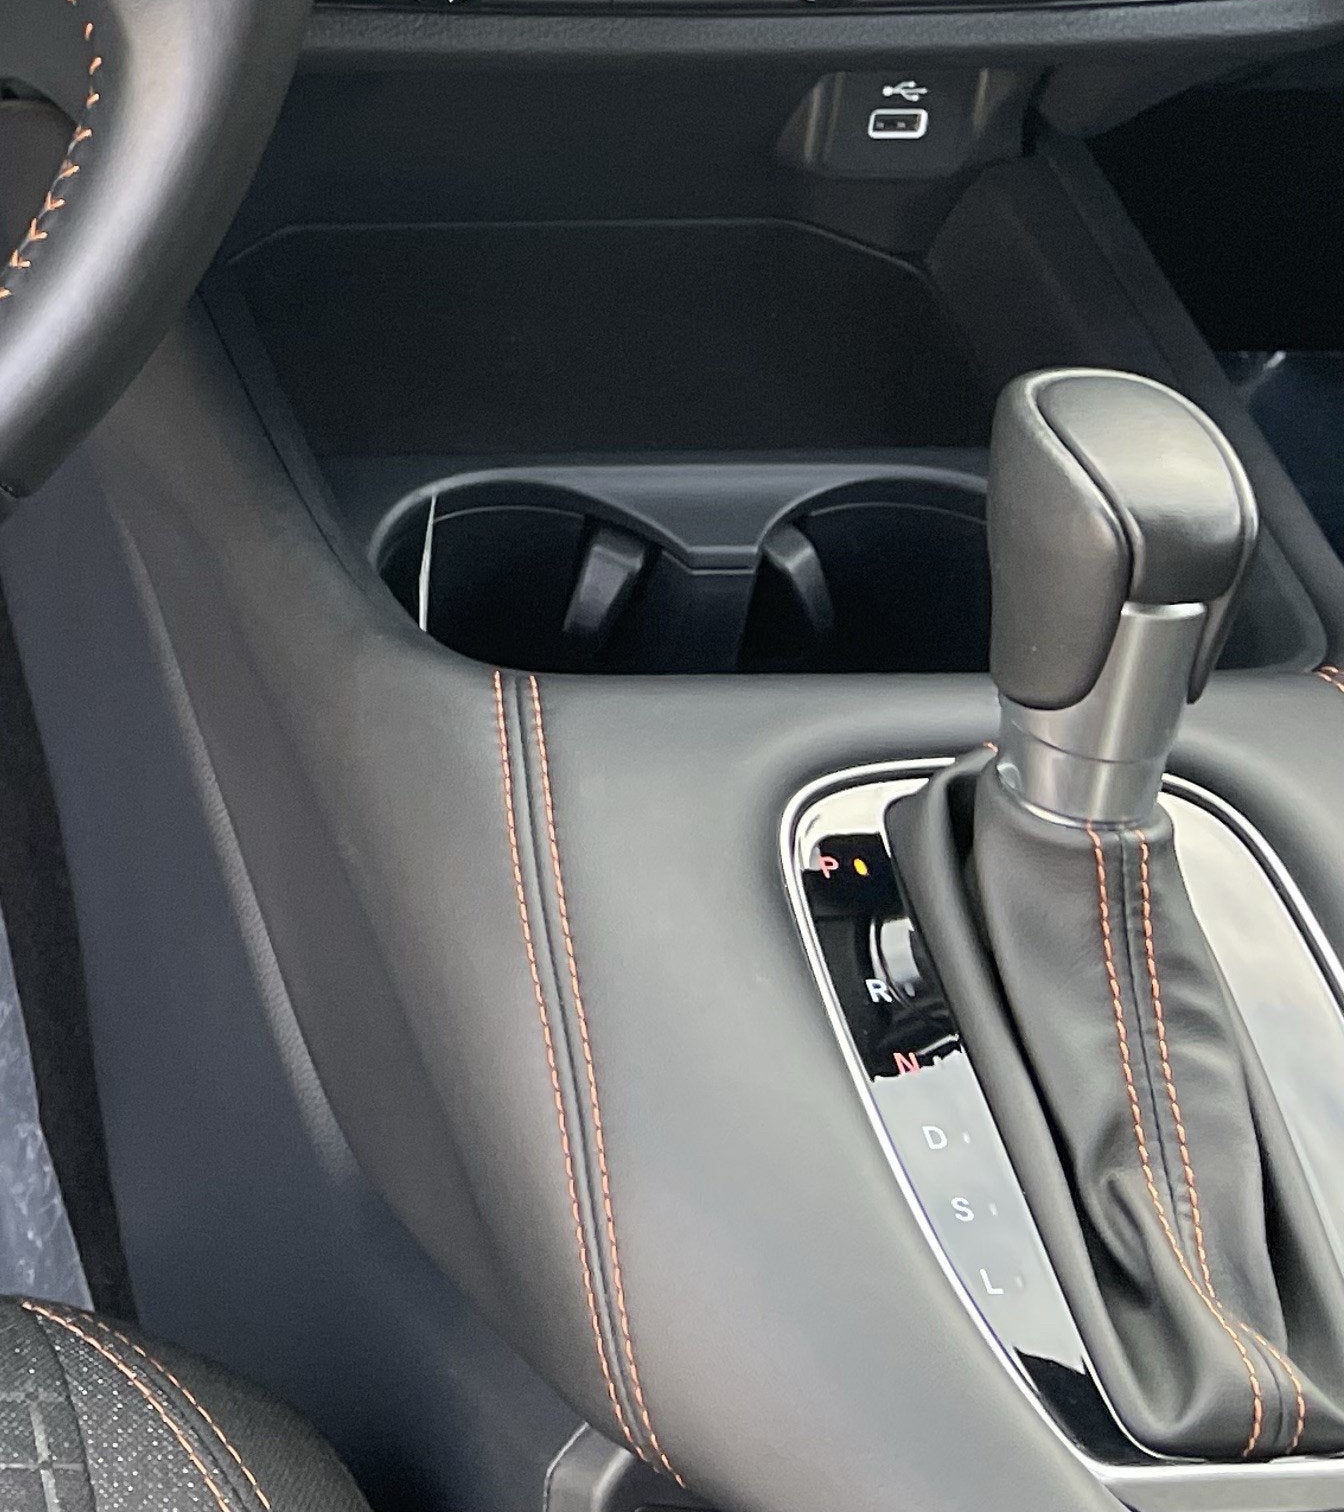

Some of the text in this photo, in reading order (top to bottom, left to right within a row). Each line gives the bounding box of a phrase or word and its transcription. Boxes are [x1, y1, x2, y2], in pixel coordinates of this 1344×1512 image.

[818, 856, 839, 878] P
[865, 979, 893, 1003] R
[893, 1052, 920, 1076] N
[923, 1125, 948, 1149] D
[951, 1197, 975, 1222] S
[980, 1269, 1004, 1295] L
